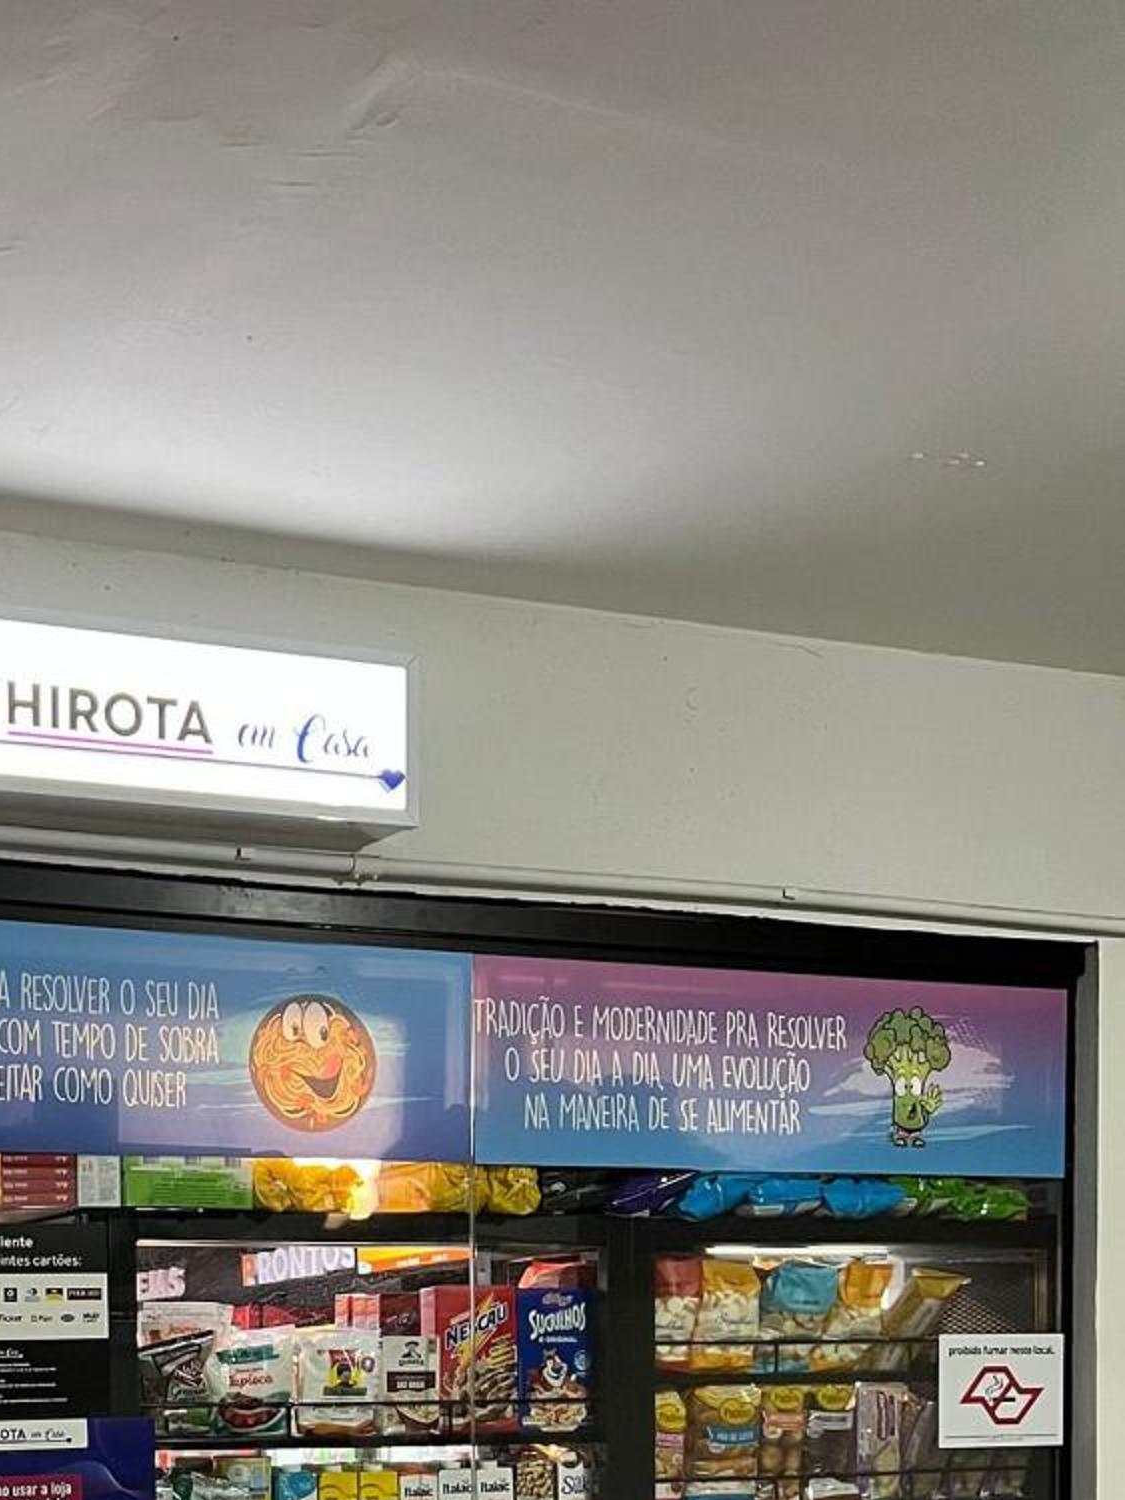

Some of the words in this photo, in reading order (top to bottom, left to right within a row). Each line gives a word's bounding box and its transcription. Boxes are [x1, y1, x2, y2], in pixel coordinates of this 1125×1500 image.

[7, 681, 212, 745] HIROTA
[237, 720, 275, 750] em
[295, 713, 370, 763] Casa
[20, 972, 111, 1016] RESOLVER
[120, 978, 135, 1015] O
[145, 981, 179, 1018] SEU
[188, 982, 219, 1019] DIA
[52, 1022, 117, 1061] TEMPO
[126, 1025, 149, 1063] DE
[158, 1027, 219, 1065] SOBRA
[474, 995, 565, 1044] TRADIÇÃO
[574, 1004, 585, 1037] E
[592, 1005, 718, 1046] MODERNIDADE
[727, 1012, 756, 1047] PRA
[767, 1013, 848, 1051] RESOLVER
[53, 1067, 112, 1105] COMO
[122, 1069, 187, 1109] QUISER
[505, 1047, 520, 1082] O
[529, 1048, 563, 1084] SEU
[574, 1050, 603, 1086] DIA
[612, 1051, 623, 1087] A
[673, 1054, 714, 1091] UMA
[723, 1051, 811, 1098] EVOLUÇÃO
[525, 1094, 551, 1131] NA
[559, 1093, 640, 1132] MANEIRA
[648, 1097, 670, 1131] DE
[679, 1098, 699, 1132] SE
[707, 1099, 801, 1136] ALIMENTAR
[32, 1253, 82, 1267] cartões:
[528, 1302, 586, 1342] SUCRILHOS
[983, 1346, 1008, 1354] fumar
[12, 1483, 37, 1496] usar
[39, 1484, 49, 1495] a
[50, 1480, 72, 1498] loja
